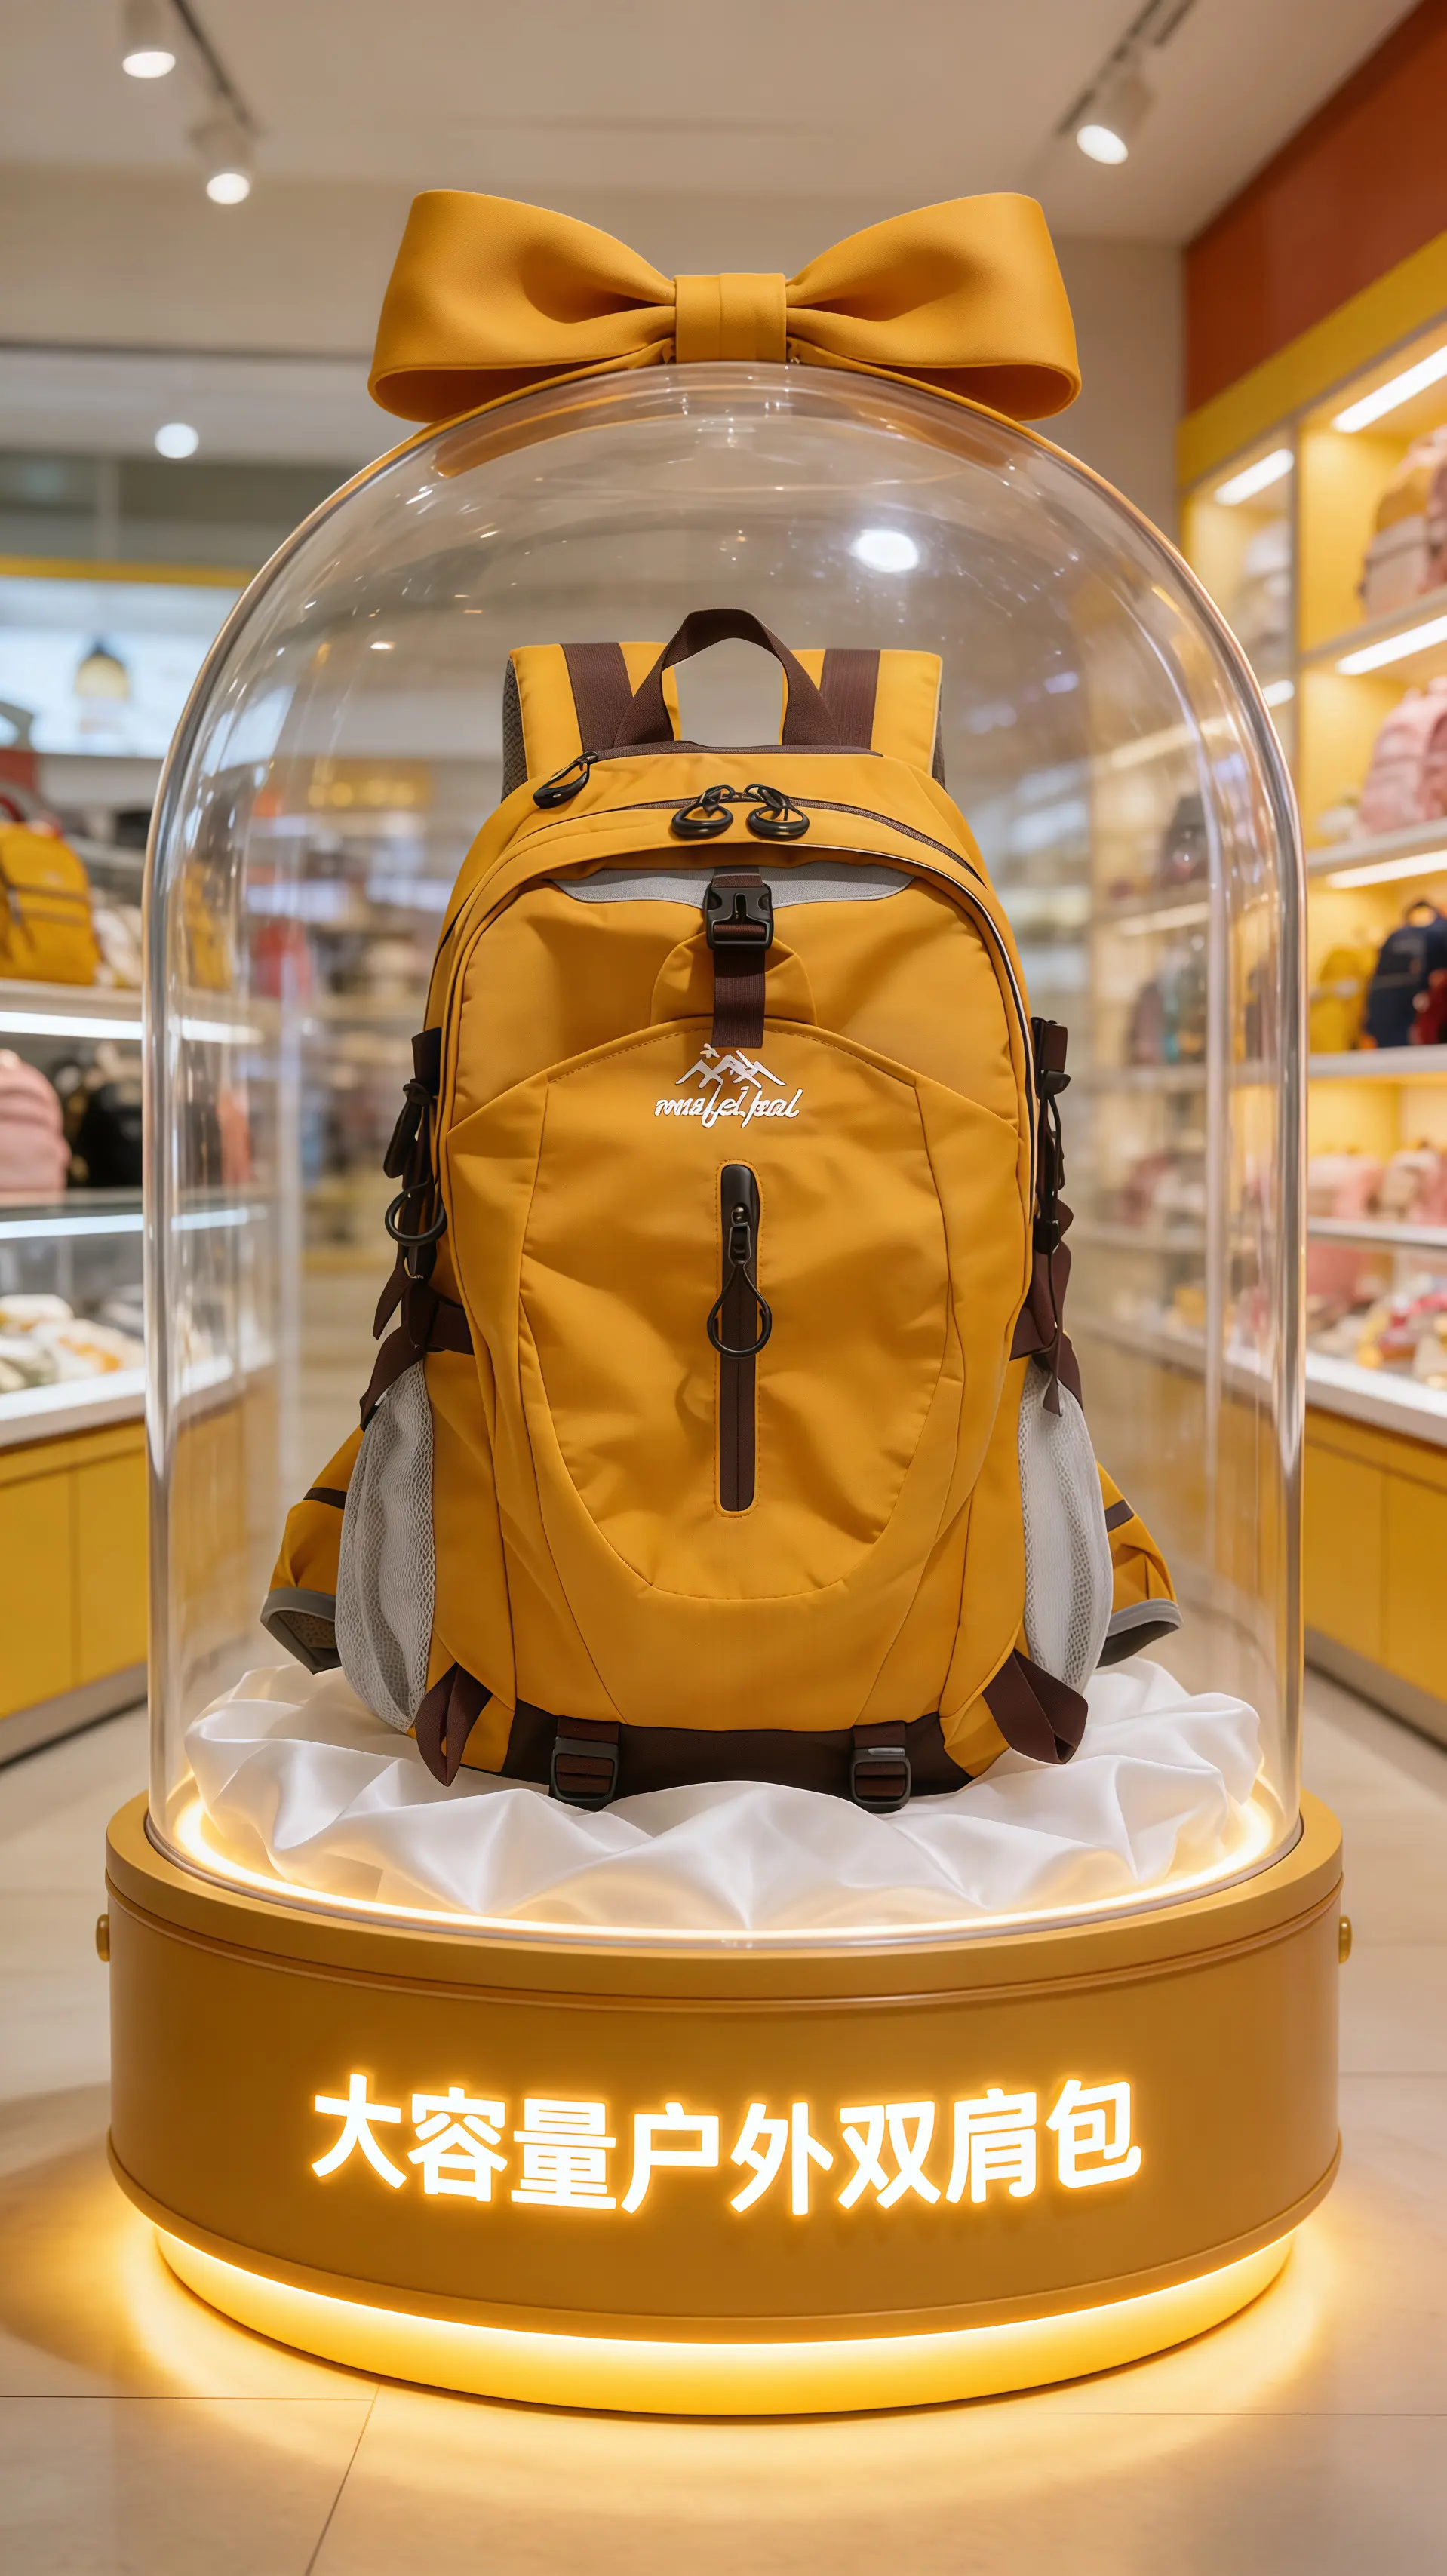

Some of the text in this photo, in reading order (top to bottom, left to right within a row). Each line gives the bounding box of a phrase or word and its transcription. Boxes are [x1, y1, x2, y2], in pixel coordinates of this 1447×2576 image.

[311, 2072, 1141, 2215] 大容量户外双肩包
